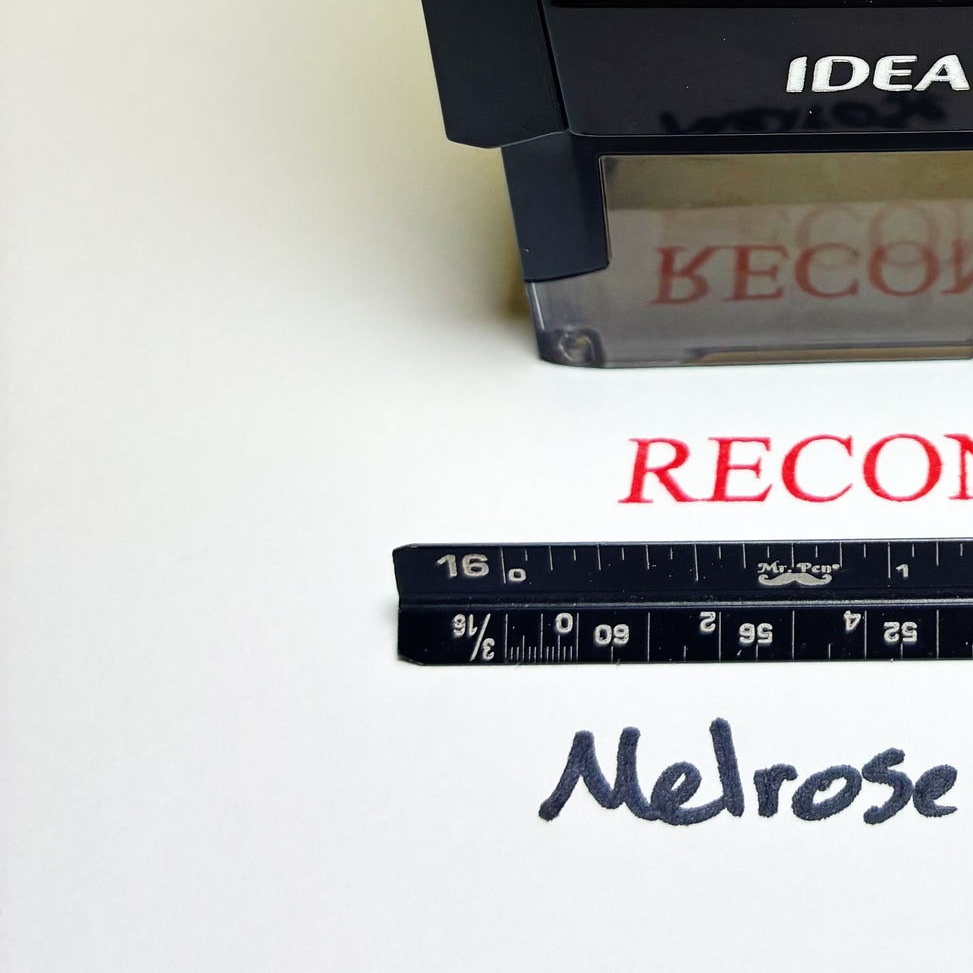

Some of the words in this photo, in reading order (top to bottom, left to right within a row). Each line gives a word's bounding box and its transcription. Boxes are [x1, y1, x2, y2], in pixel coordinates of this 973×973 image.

[437, 554, 489, 577] 16
[508, 569, 526, 581] 0
[757, 560, 792, 573] Mr.
[896, 564, 908, 577] 1
[595, 624, 629, 645] 60
[739, 623, 772, 645] 56
[884, 622, 917, 643] 52
[539, 719, 957, 826] Melrose
